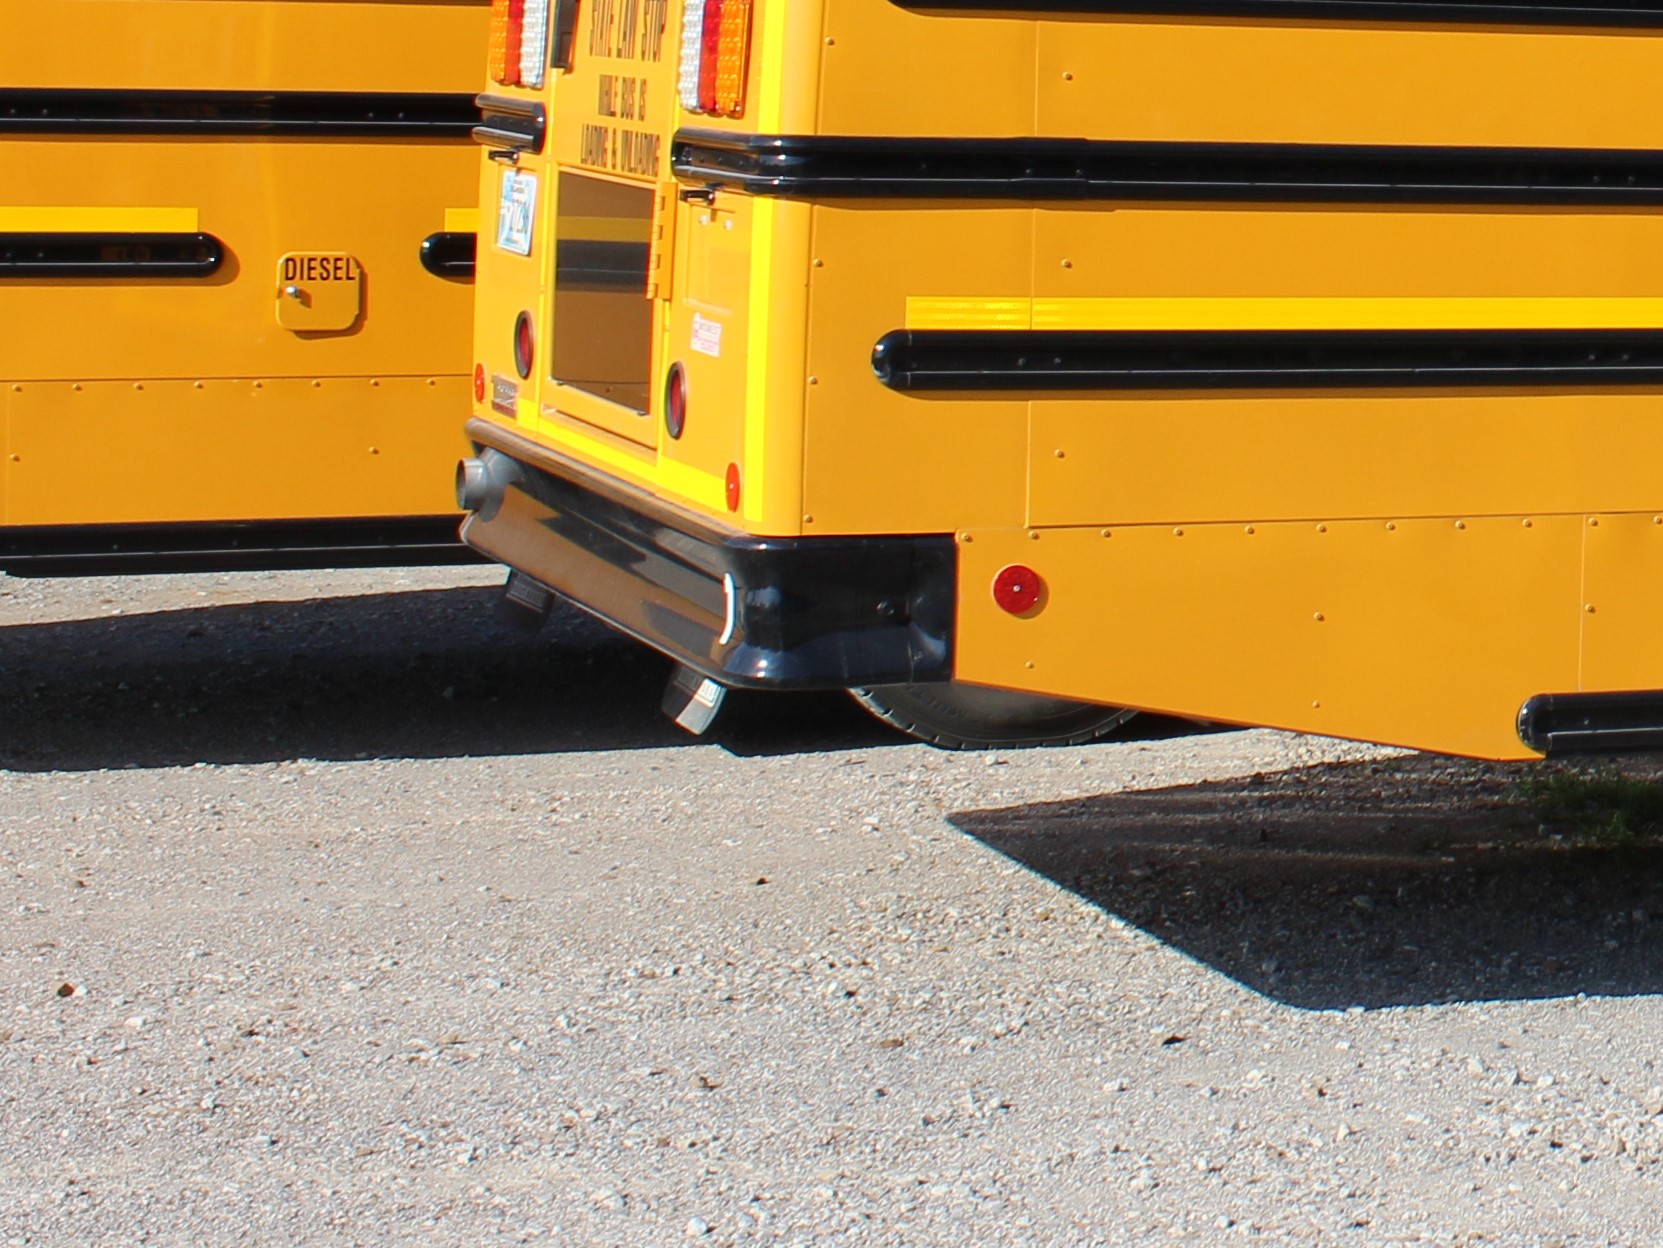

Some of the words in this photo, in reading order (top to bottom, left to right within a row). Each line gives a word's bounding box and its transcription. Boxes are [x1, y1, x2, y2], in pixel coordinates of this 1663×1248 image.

[620, 76, 636, 120] BUS
[638, 78, 647, 122] IS
[285, 257, 356, 281] DIESEL
